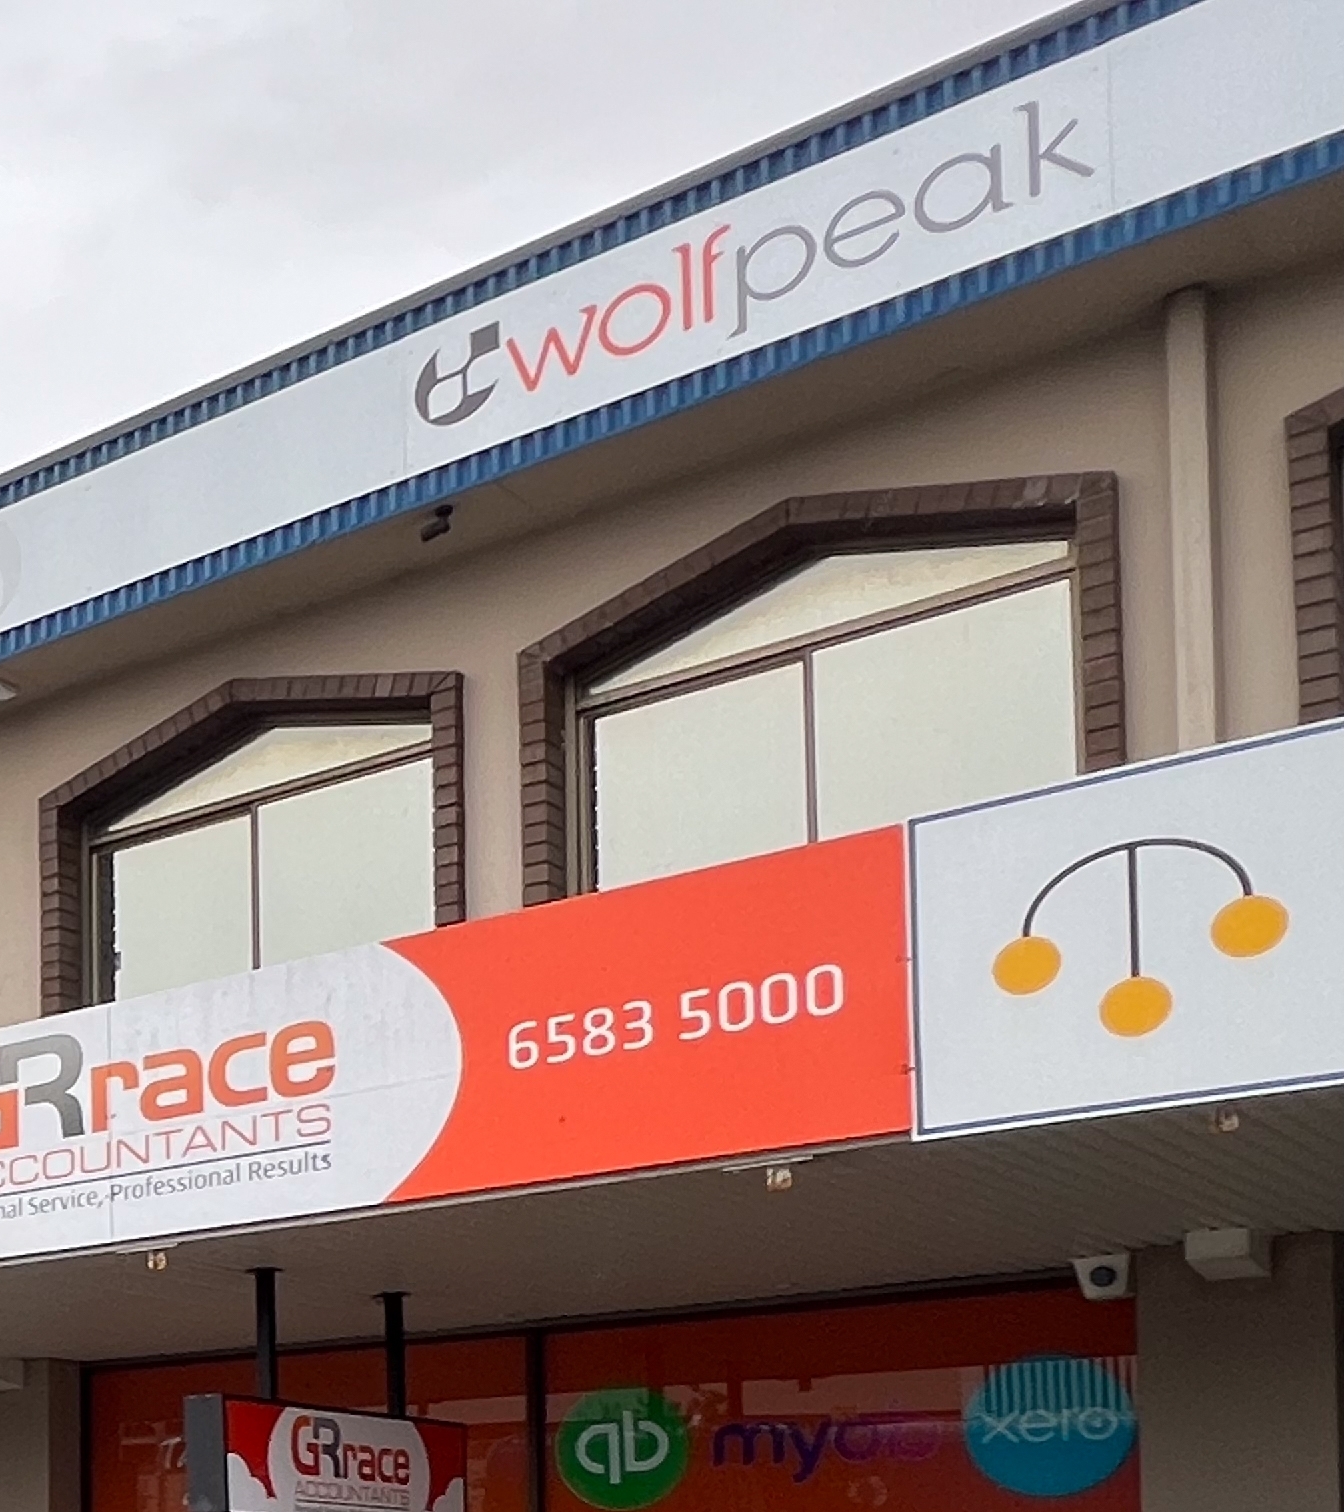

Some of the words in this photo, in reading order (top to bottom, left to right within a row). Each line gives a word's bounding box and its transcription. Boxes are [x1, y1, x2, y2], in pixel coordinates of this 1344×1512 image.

[504, 100, 1097, 394] wolfpeak
[506, 999, 655, 1071] 6583
[676, 961, 846, 1043] 5000
[28, 1187, 104, 1217] Service,
[110, 1163, 242, 1204] Professional
[248, 1151, 332, 1181] Results
[291, 1415, 410, 1485] GRrace
[980, 1405, 1119, 1446] xero
[294, 1480, 410, 1506] ACCOUNTANTS
